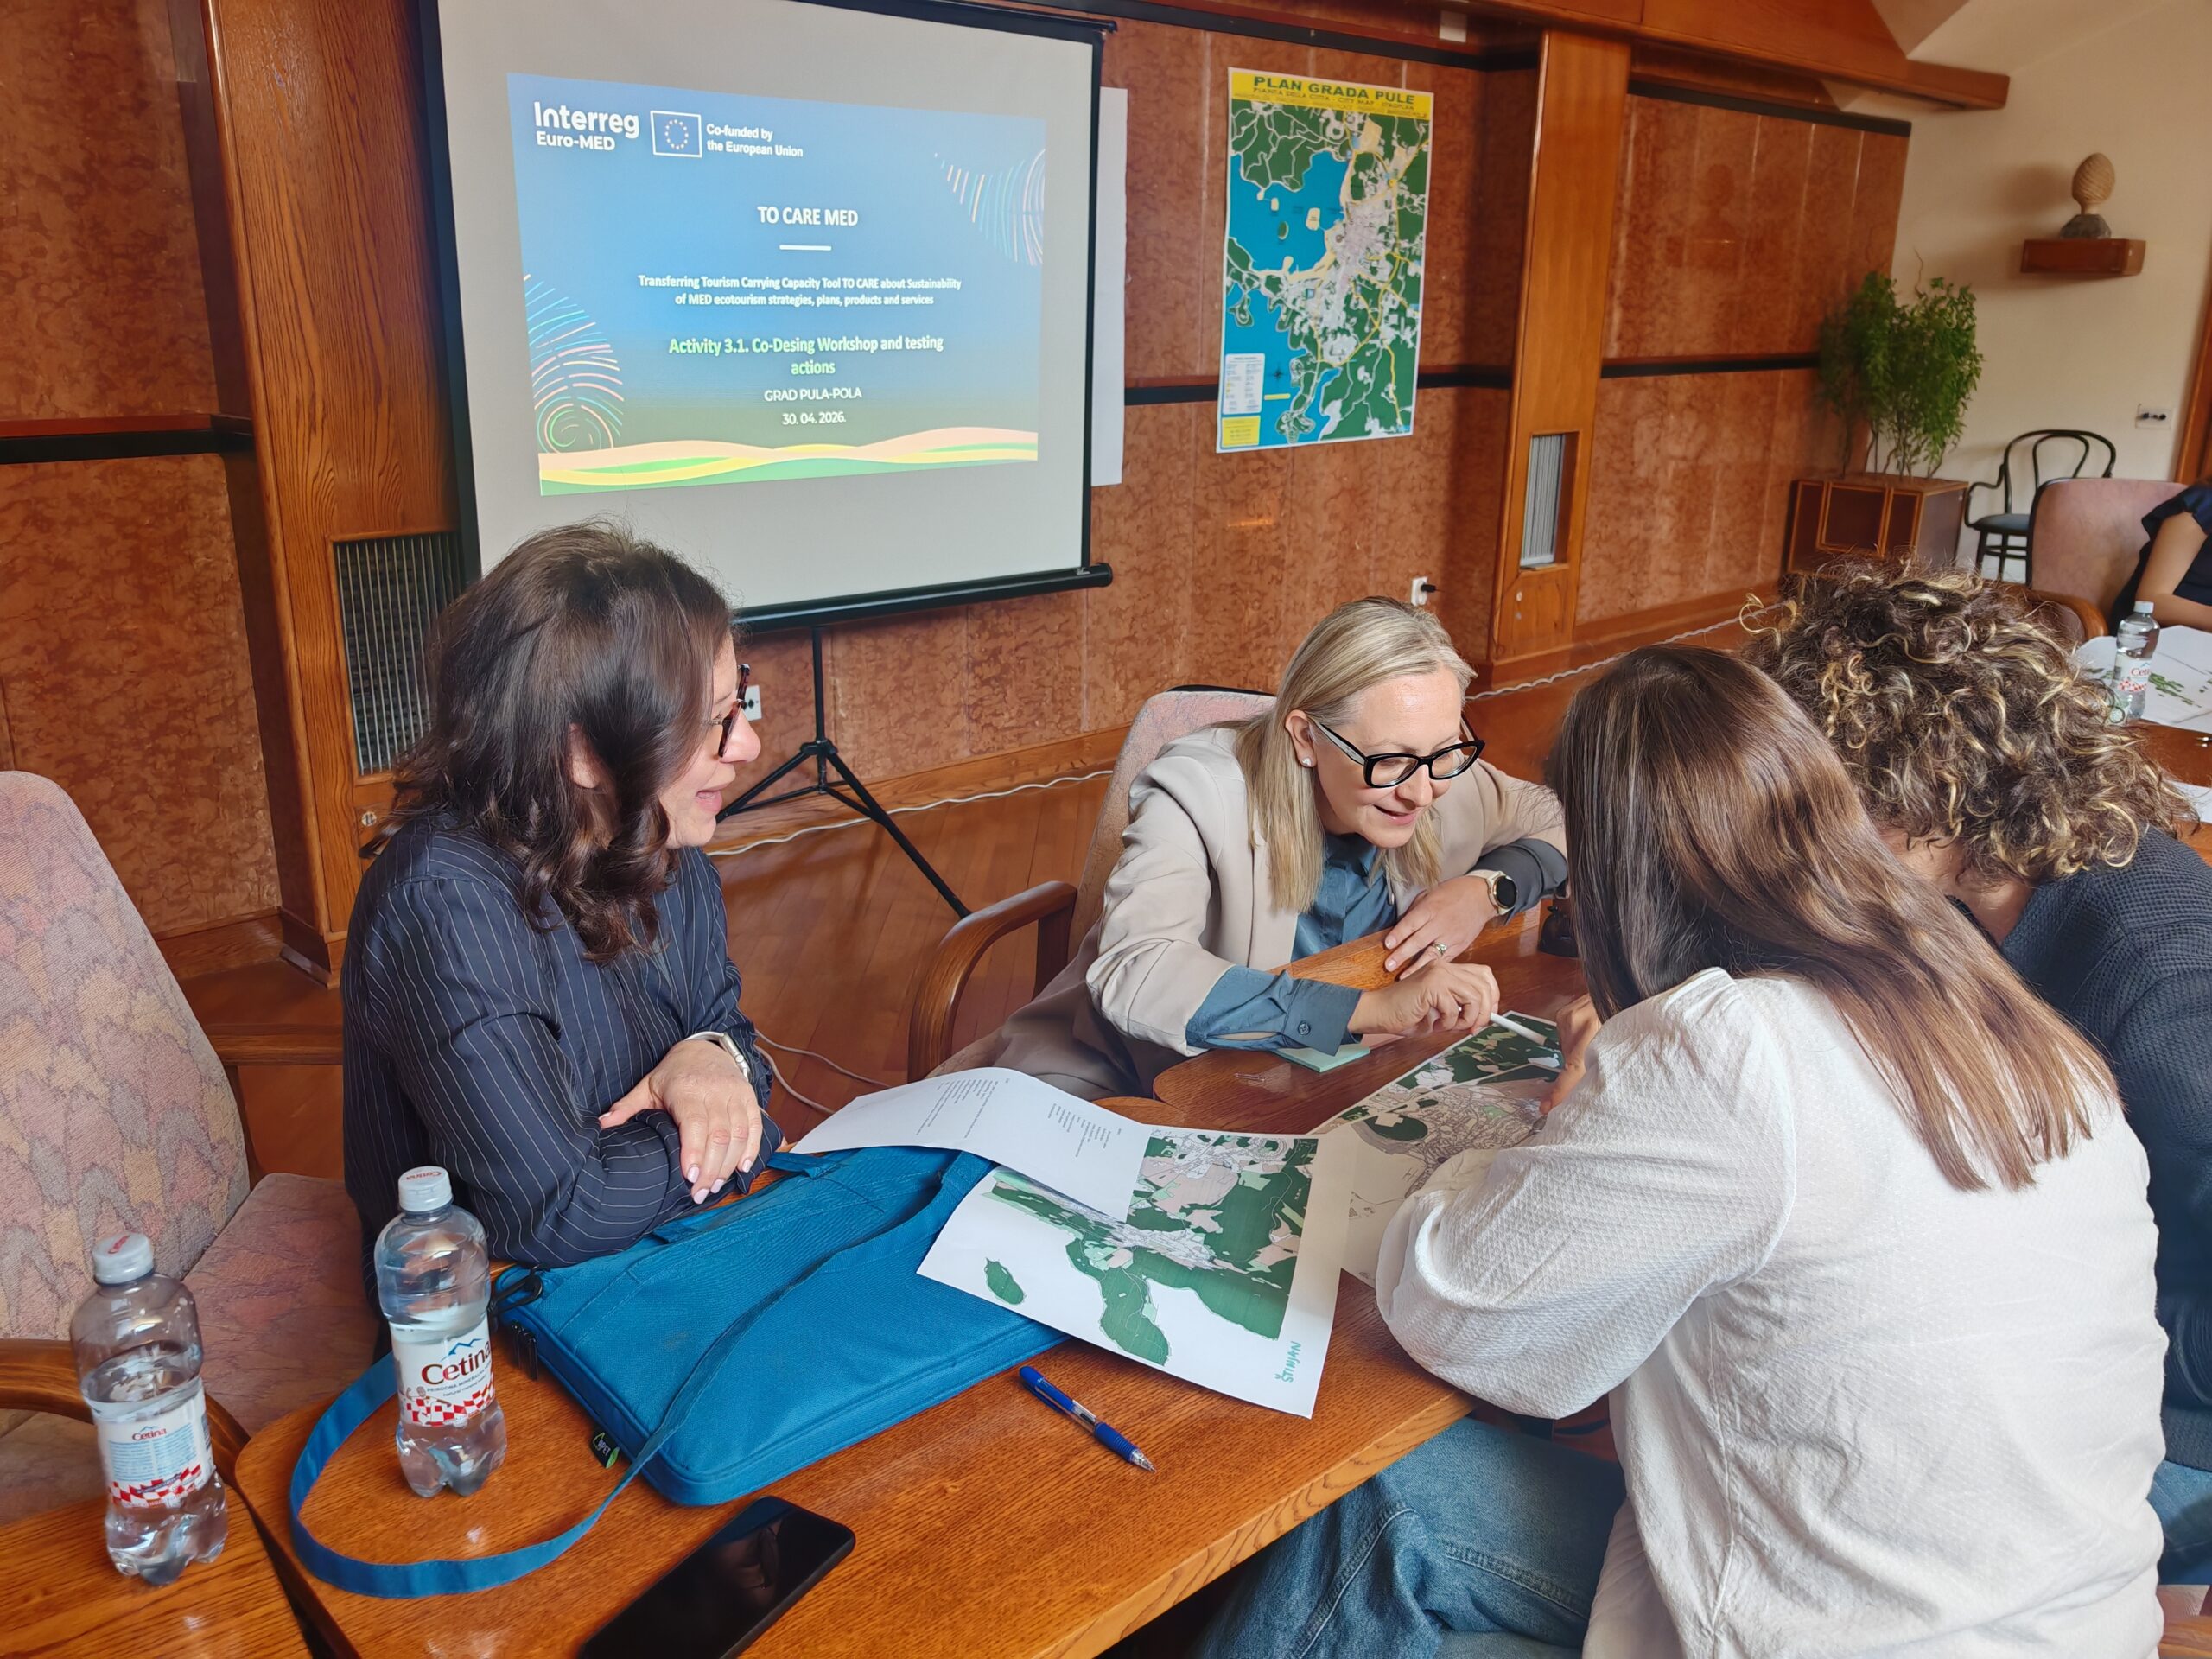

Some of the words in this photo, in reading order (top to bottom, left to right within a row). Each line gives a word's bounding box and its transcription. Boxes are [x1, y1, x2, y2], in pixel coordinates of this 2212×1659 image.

[1254, 76, 1301, 91] PLAN
[1308, 83, 1369, 99] GRADA
[1376, 91, 1414, 104] PULE
[534, 101, 639, 138] Interreg
[537, 130, 615, 150] Euro-MED
[706, 123, 759, 139] Co-funded
[760, 128, 773, 142] by
[707, 140, 724, 151] the
[726, 141, 772, 156] European
[775, 144, 804, 157] Union
[757, 206, 779, 224] TO
[782, 207, 821, 225] CARE
[824, 208, 858, 226] MED
[638, 275, 700, 289] Transferring
[701, 276, 740, 288] Tourism
[741, 276, 780, 290] Carrying
[782, 277, 820, 290] Capacity
[822, 277, 841, 289] Tool
[842, 278, 855, 289] TO
[856, 278, 879, 289] CARE
[880, 278, 906, 289] about
[907, 278, 962, 290] Sustainability
[675, 293, 687, 305] of
[688, 294, 712, 305] MED
[714, 294, 766, 305] ecotourism
[768, 295, 815, 308] strategies,
[817, 295, 843, 307] plans,
[844, 295, 882, 307] products
[883, 295, 900, 305] and
[901, 295, 934, 305] services
[669, 338, 721, 356] Activity
[724, 338, 749, 353] 3.1.
[752, 337, 815, 354] Co-Desing
[817, 336, 878, 353] Workshop
[880, 335, 903, 351] and
[905, 335, 944, 352] testing
[791, 359, 836, 375] actions
[764, 389, 798, 402] GRAD
[799, 387, 862, 400] PULA-POLA
[782, 413, 799, 425] 30.
[800, 412, 817, 424] 04.
[818, 411, 847, 423] 2026.
[421, 1340, 492, 1385] Cetina
[132, 1428, 167, 1441] Cetina
